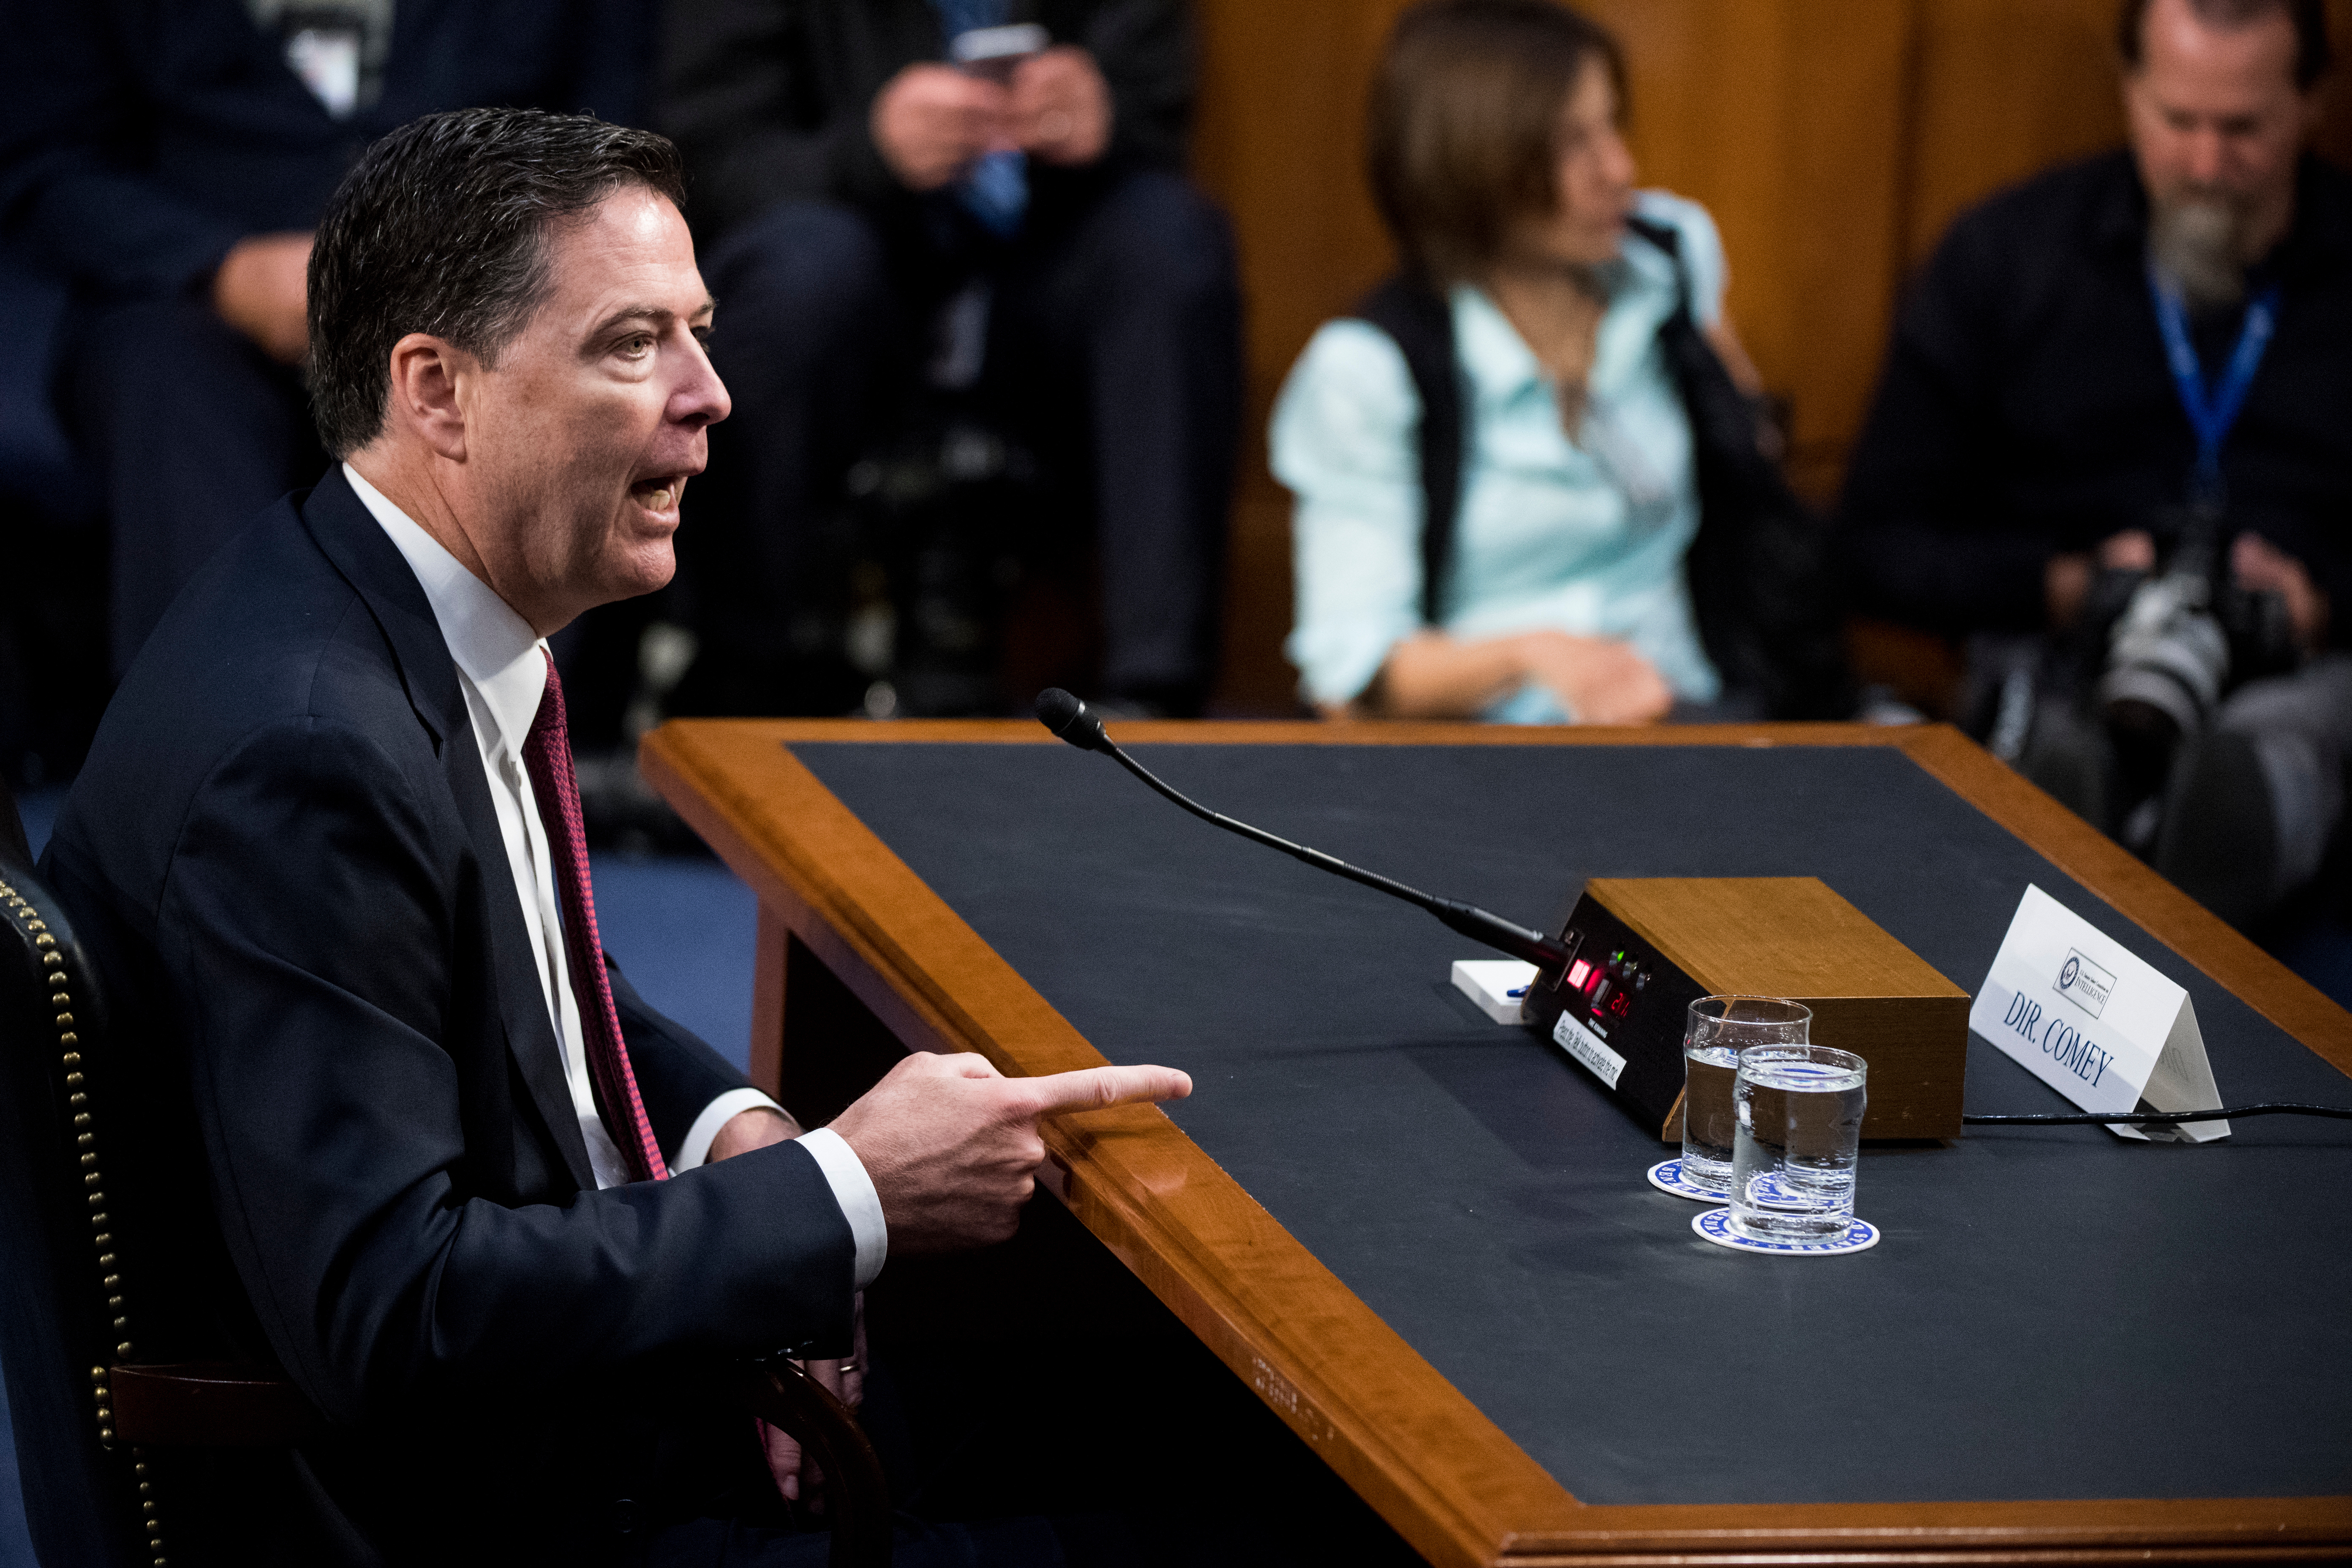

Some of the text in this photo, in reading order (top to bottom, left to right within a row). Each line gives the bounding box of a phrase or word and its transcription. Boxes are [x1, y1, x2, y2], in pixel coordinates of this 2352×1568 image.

[2074, 976, 2106, 1005] INTELLIGENCE
[2004, 991, 2114, 1088] DIR. COMEY
[1590, 1052, 1606, 1072] activate
[1603, 1058, 1612, 1076] the
[1608, 1064, 1618, 1081] mic
[1659, 1167, 1712, 1196] SENATE
